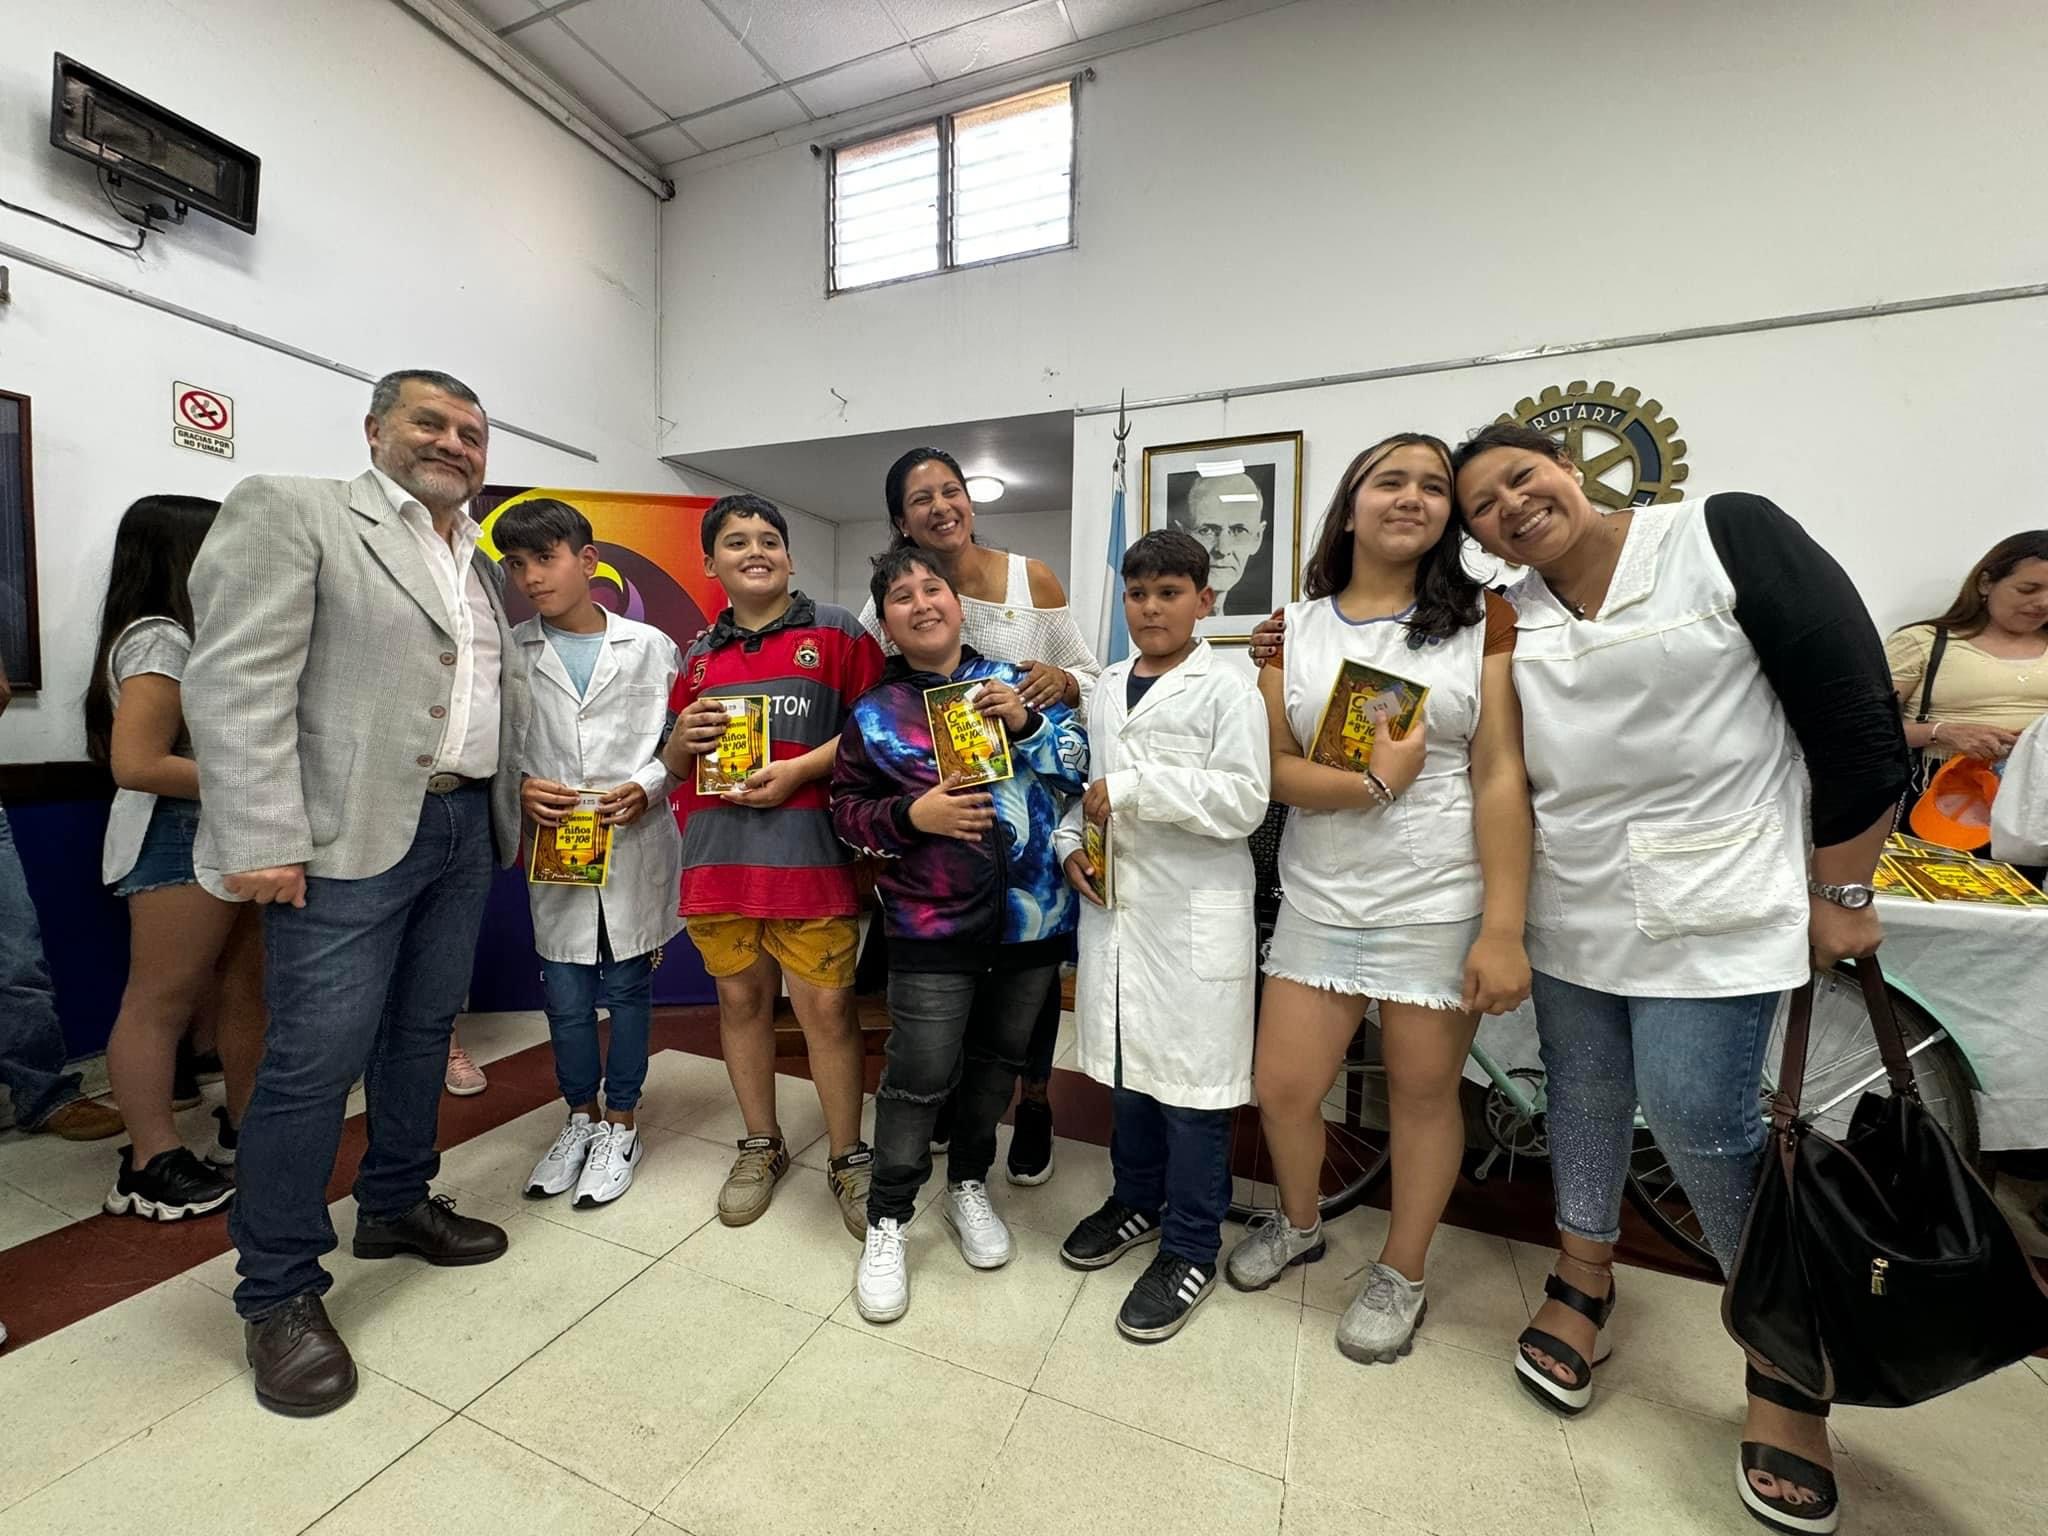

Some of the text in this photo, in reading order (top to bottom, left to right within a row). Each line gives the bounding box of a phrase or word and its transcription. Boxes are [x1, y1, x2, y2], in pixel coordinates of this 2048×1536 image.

[1532, 404, 1620, 430] ROTARY
[178, 430, 230, 449] GRACIAS POR
[184, 438, 225, 454] NO FUMAR
[721, 733, 747, 743] niños
[564, 825, 592, 835] niños
[575, 835, 591, 844] 108
